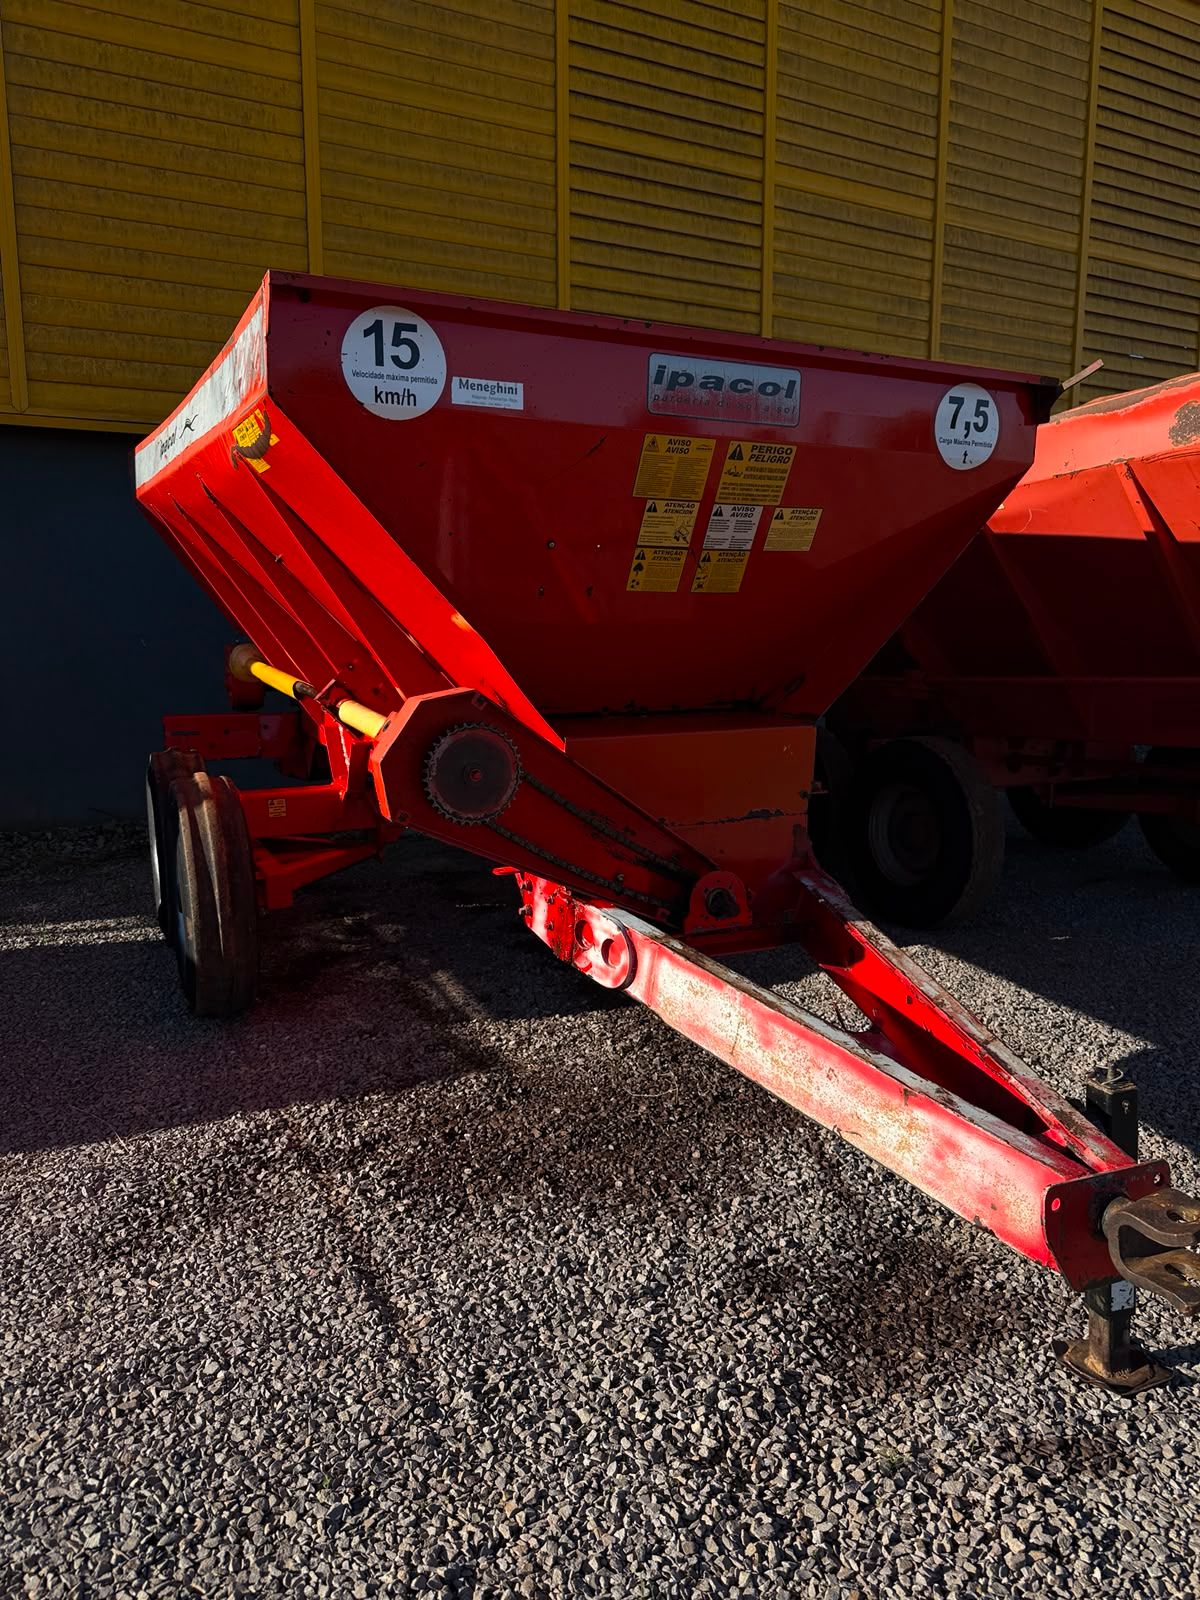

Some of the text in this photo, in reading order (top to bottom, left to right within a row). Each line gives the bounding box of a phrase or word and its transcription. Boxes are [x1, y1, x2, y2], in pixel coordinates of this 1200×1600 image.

[363, 319, 421, 370] 15
[351, 369, 438, 385] Velocidade máxima permitida
[653, 364, 797, 400] ipacol
[374, 385, 417, 407] km/h
[948, 395, 990, 440] 7,5
[665, 446, 690, 455] AVISO
[667, 438, 692, 447] AVISO
[750, 444, 794, 456] PERIGO
[748, 453, 791, 465] PELIGRO
